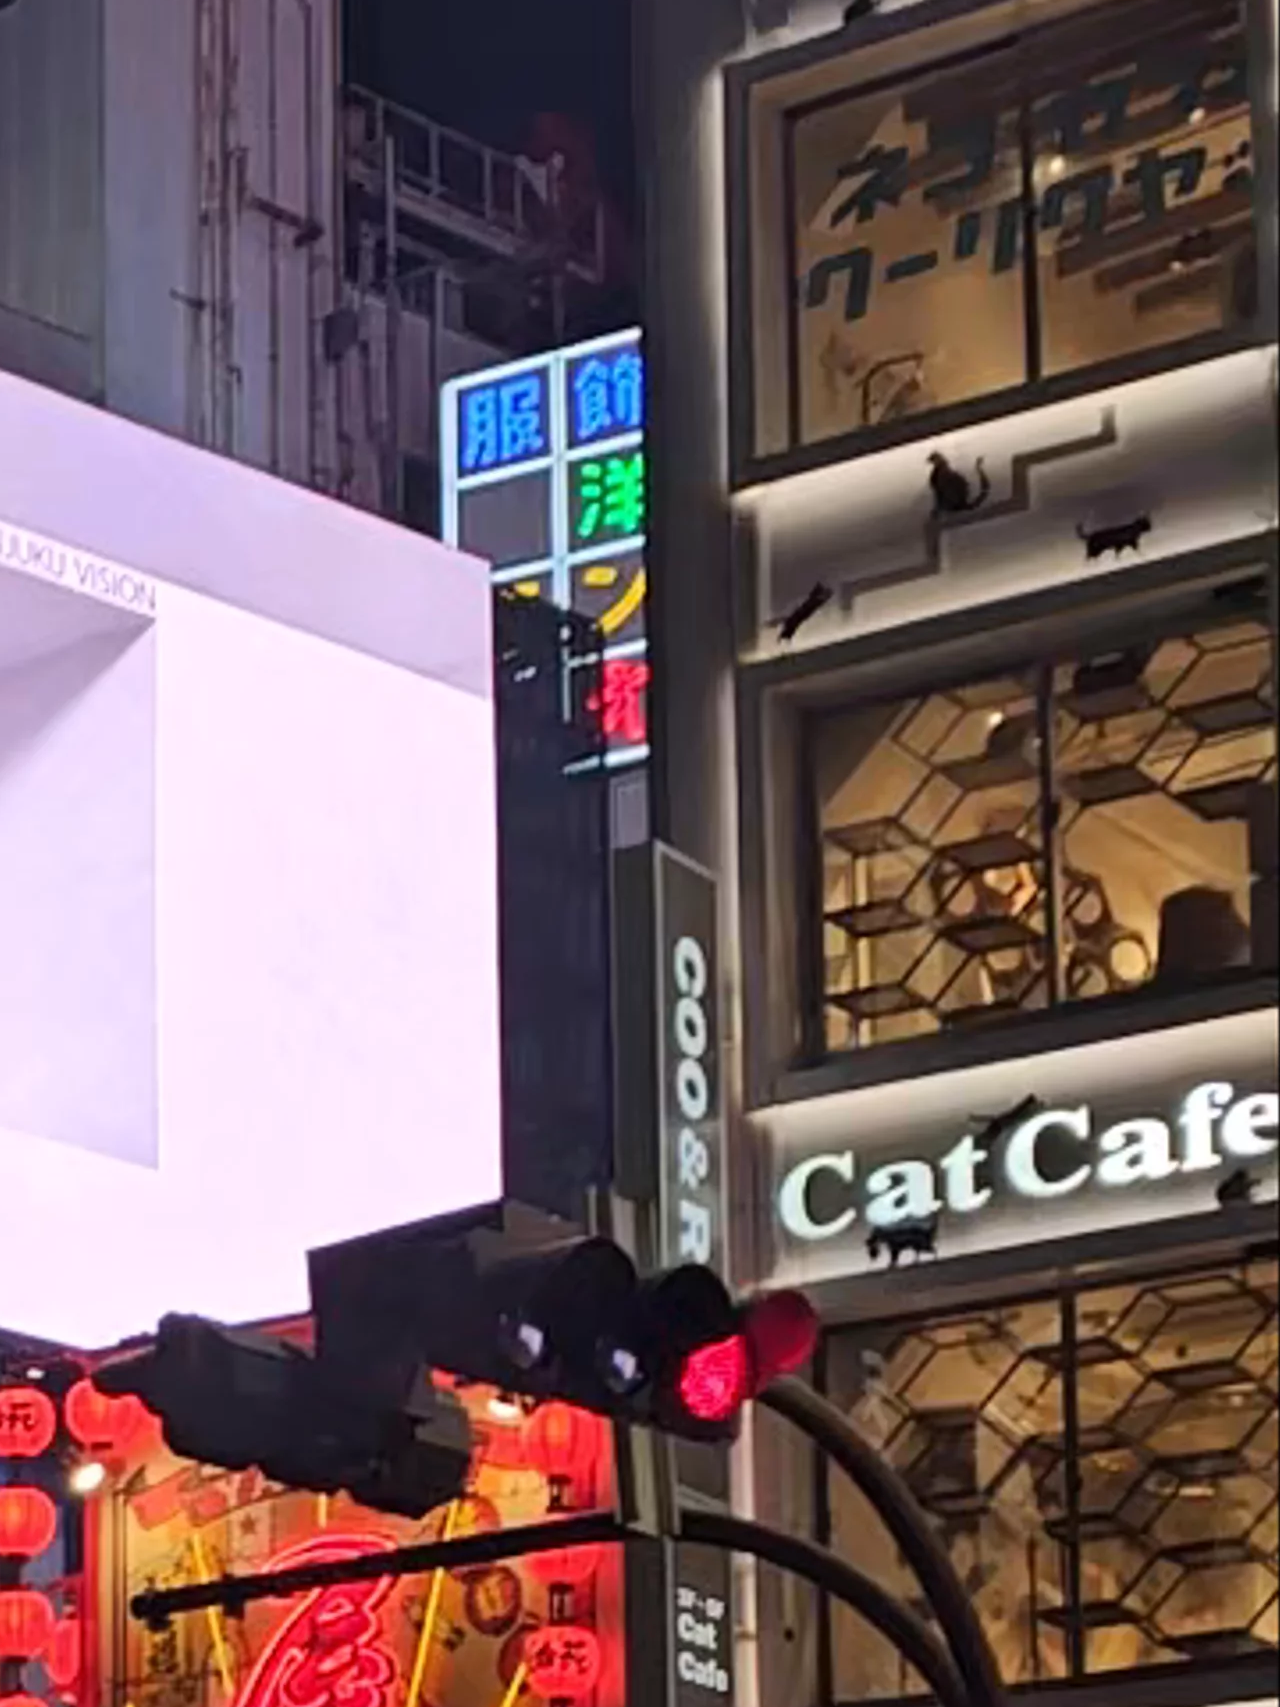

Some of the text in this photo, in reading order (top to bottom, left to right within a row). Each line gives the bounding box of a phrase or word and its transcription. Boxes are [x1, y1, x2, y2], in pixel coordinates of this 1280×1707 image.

[72, 555, 157, 611] VISION
[778, 1080, 1280, 1241] Cat Cafe
[677, 1612, 718, 1650] Cat
